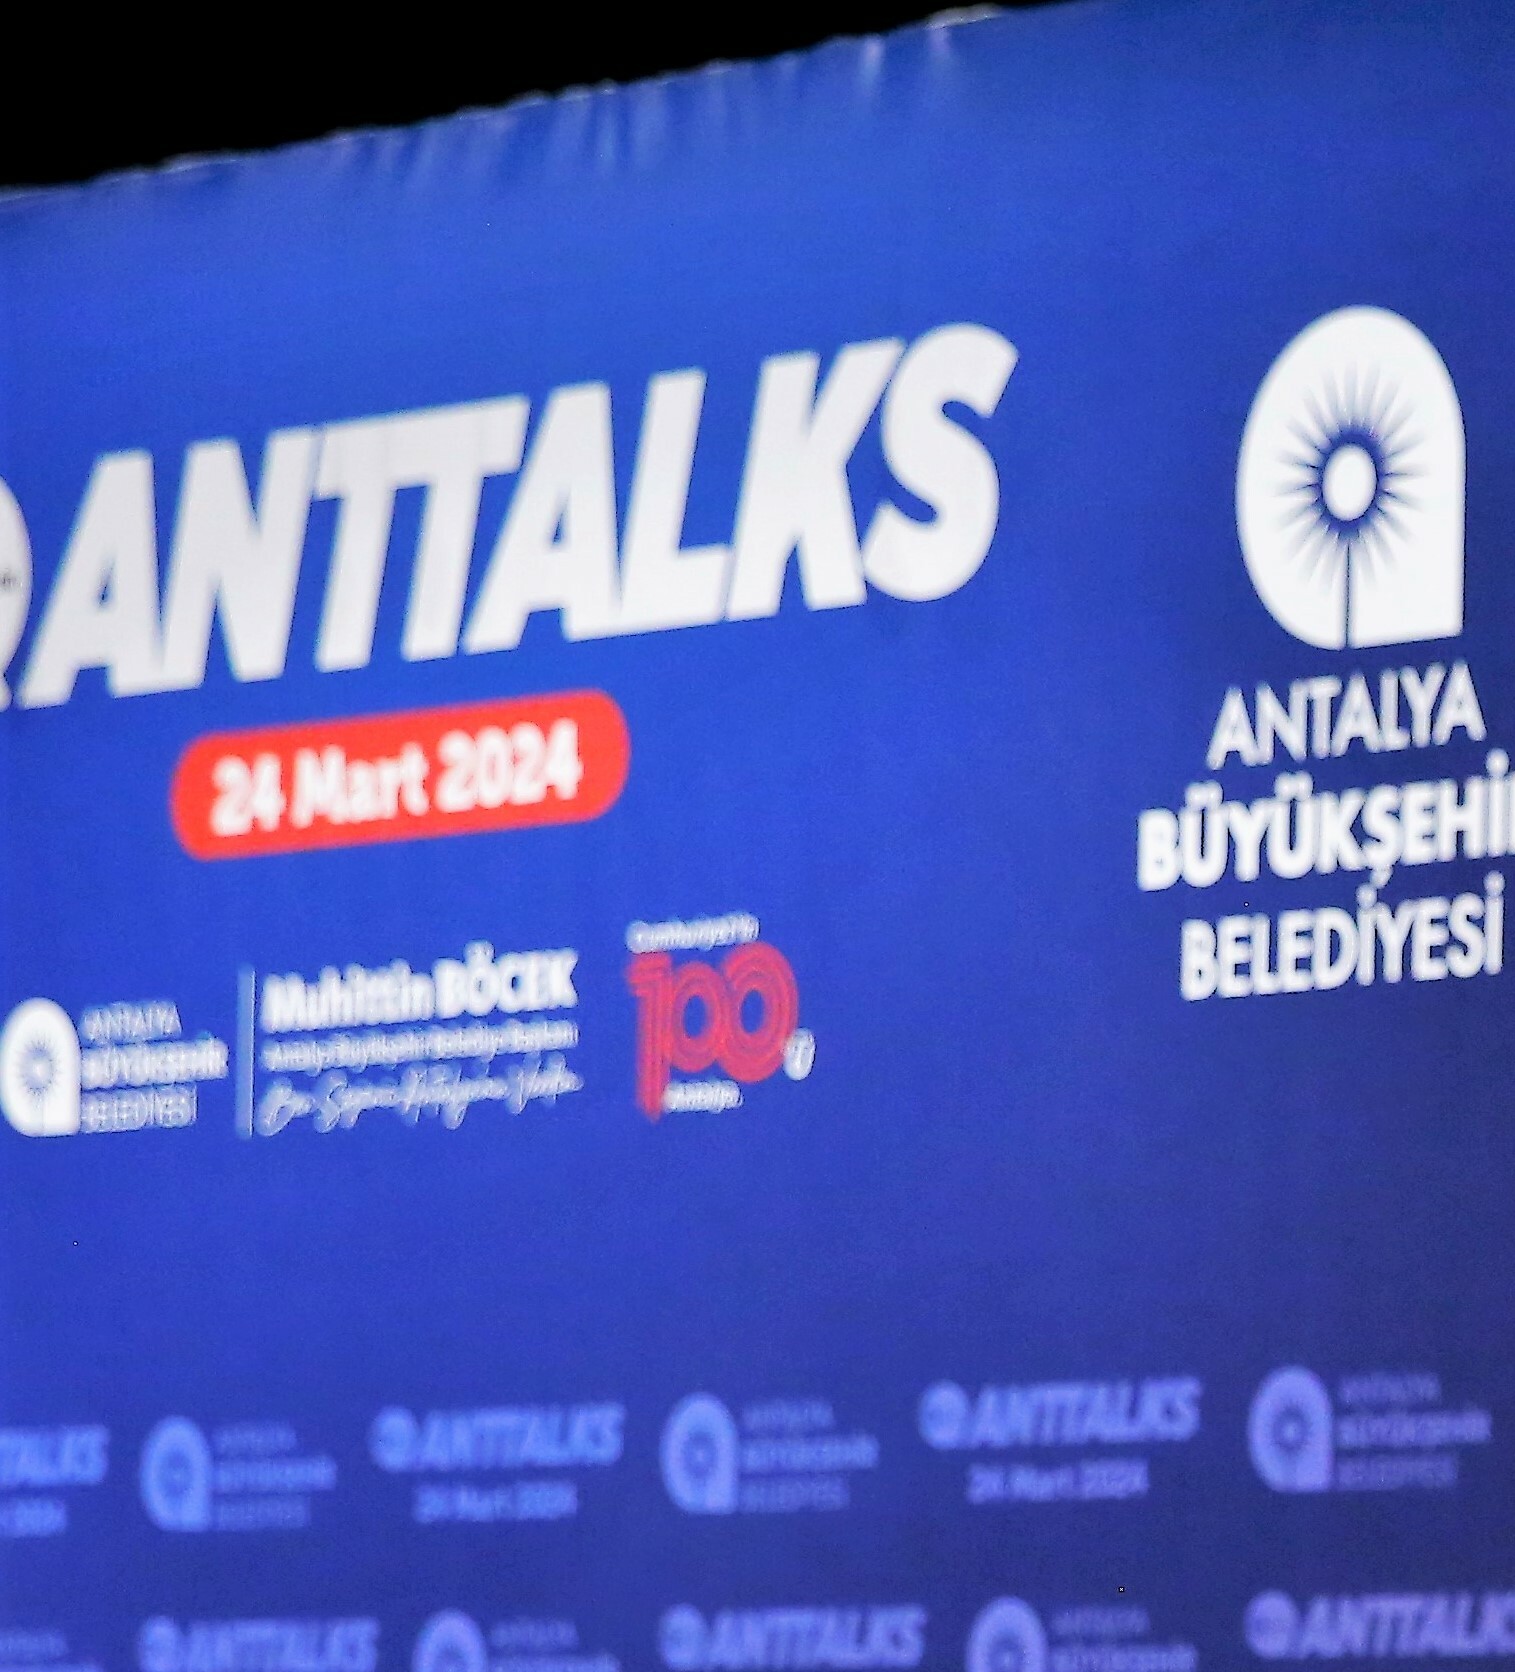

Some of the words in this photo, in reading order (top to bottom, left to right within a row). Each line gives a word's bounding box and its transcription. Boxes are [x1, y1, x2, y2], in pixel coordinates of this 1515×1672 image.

[18, 323, 1018, 709] ANTTALKS
[1206, 660, 1487, 770] ANTALYA
[210, 752, 285, 837] 24
[290, 737, 427, 827] Mart
[438, 718, 584, 807] 2024
[434, 940, 578, 1019] BÖCEK
[1179, 871, 1504, 1002] BELEDİYESİ
